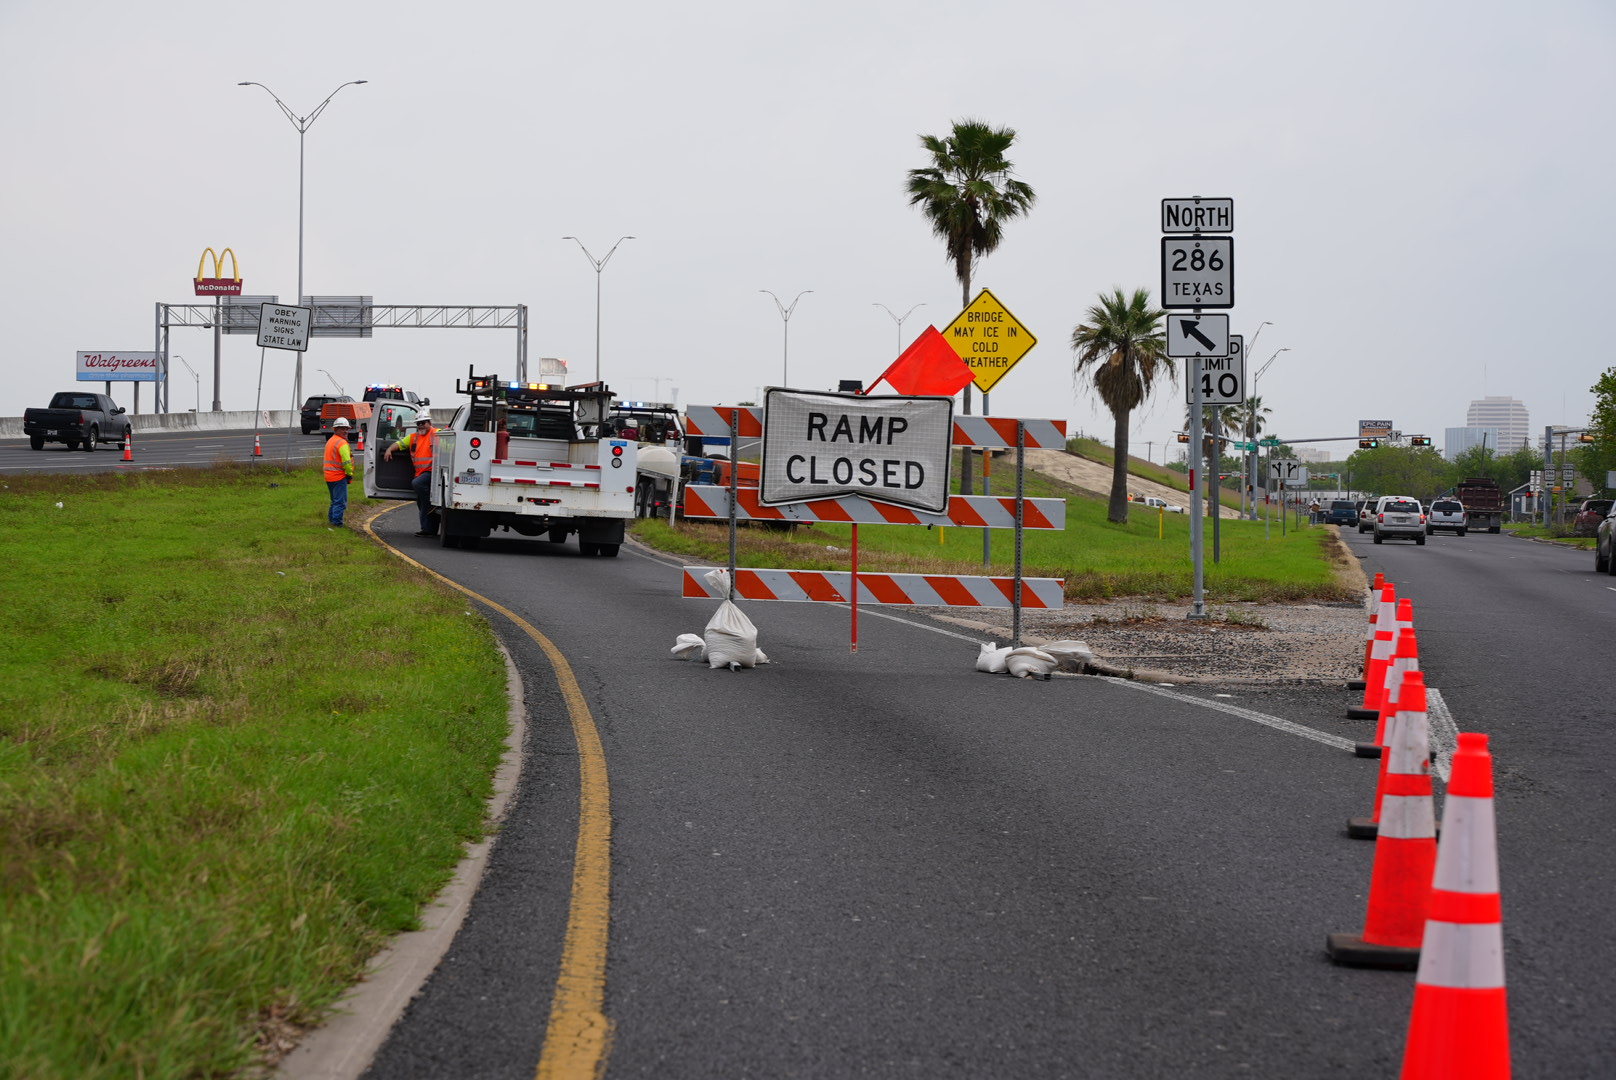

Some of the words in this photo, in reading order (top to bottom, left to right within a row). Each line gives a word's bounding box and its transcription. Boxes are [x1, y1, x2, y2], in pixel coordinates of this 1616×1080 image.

[1166, 204, 1229, 227] NORTH
[1172, 248, 1224, 271] 286
[1172, 282, 1224, 296] TEXAS
[275, 308, 297, 317] OBEY
[967, 311, 1004, 323] BRIDGE
[269, 317, 301, 327] WARNING
[273, 326, 295, 335] SIGNS
[954, 326, 975, 337] MAY
[983, 326, 999, 337] ICE
[1007, 326, 1017, 337] IN
[263, 335, 285, 345] STATE
[287, 338, 302, 347] LAW
[972, 341, 999, 352] COLD
[84, 354, 156, 371] Walgreens
[1202, 357, 1234, 370] IMIT
[807, 412, 908, 445] RAMP
[786, 454, 925, 490] CLOSED
